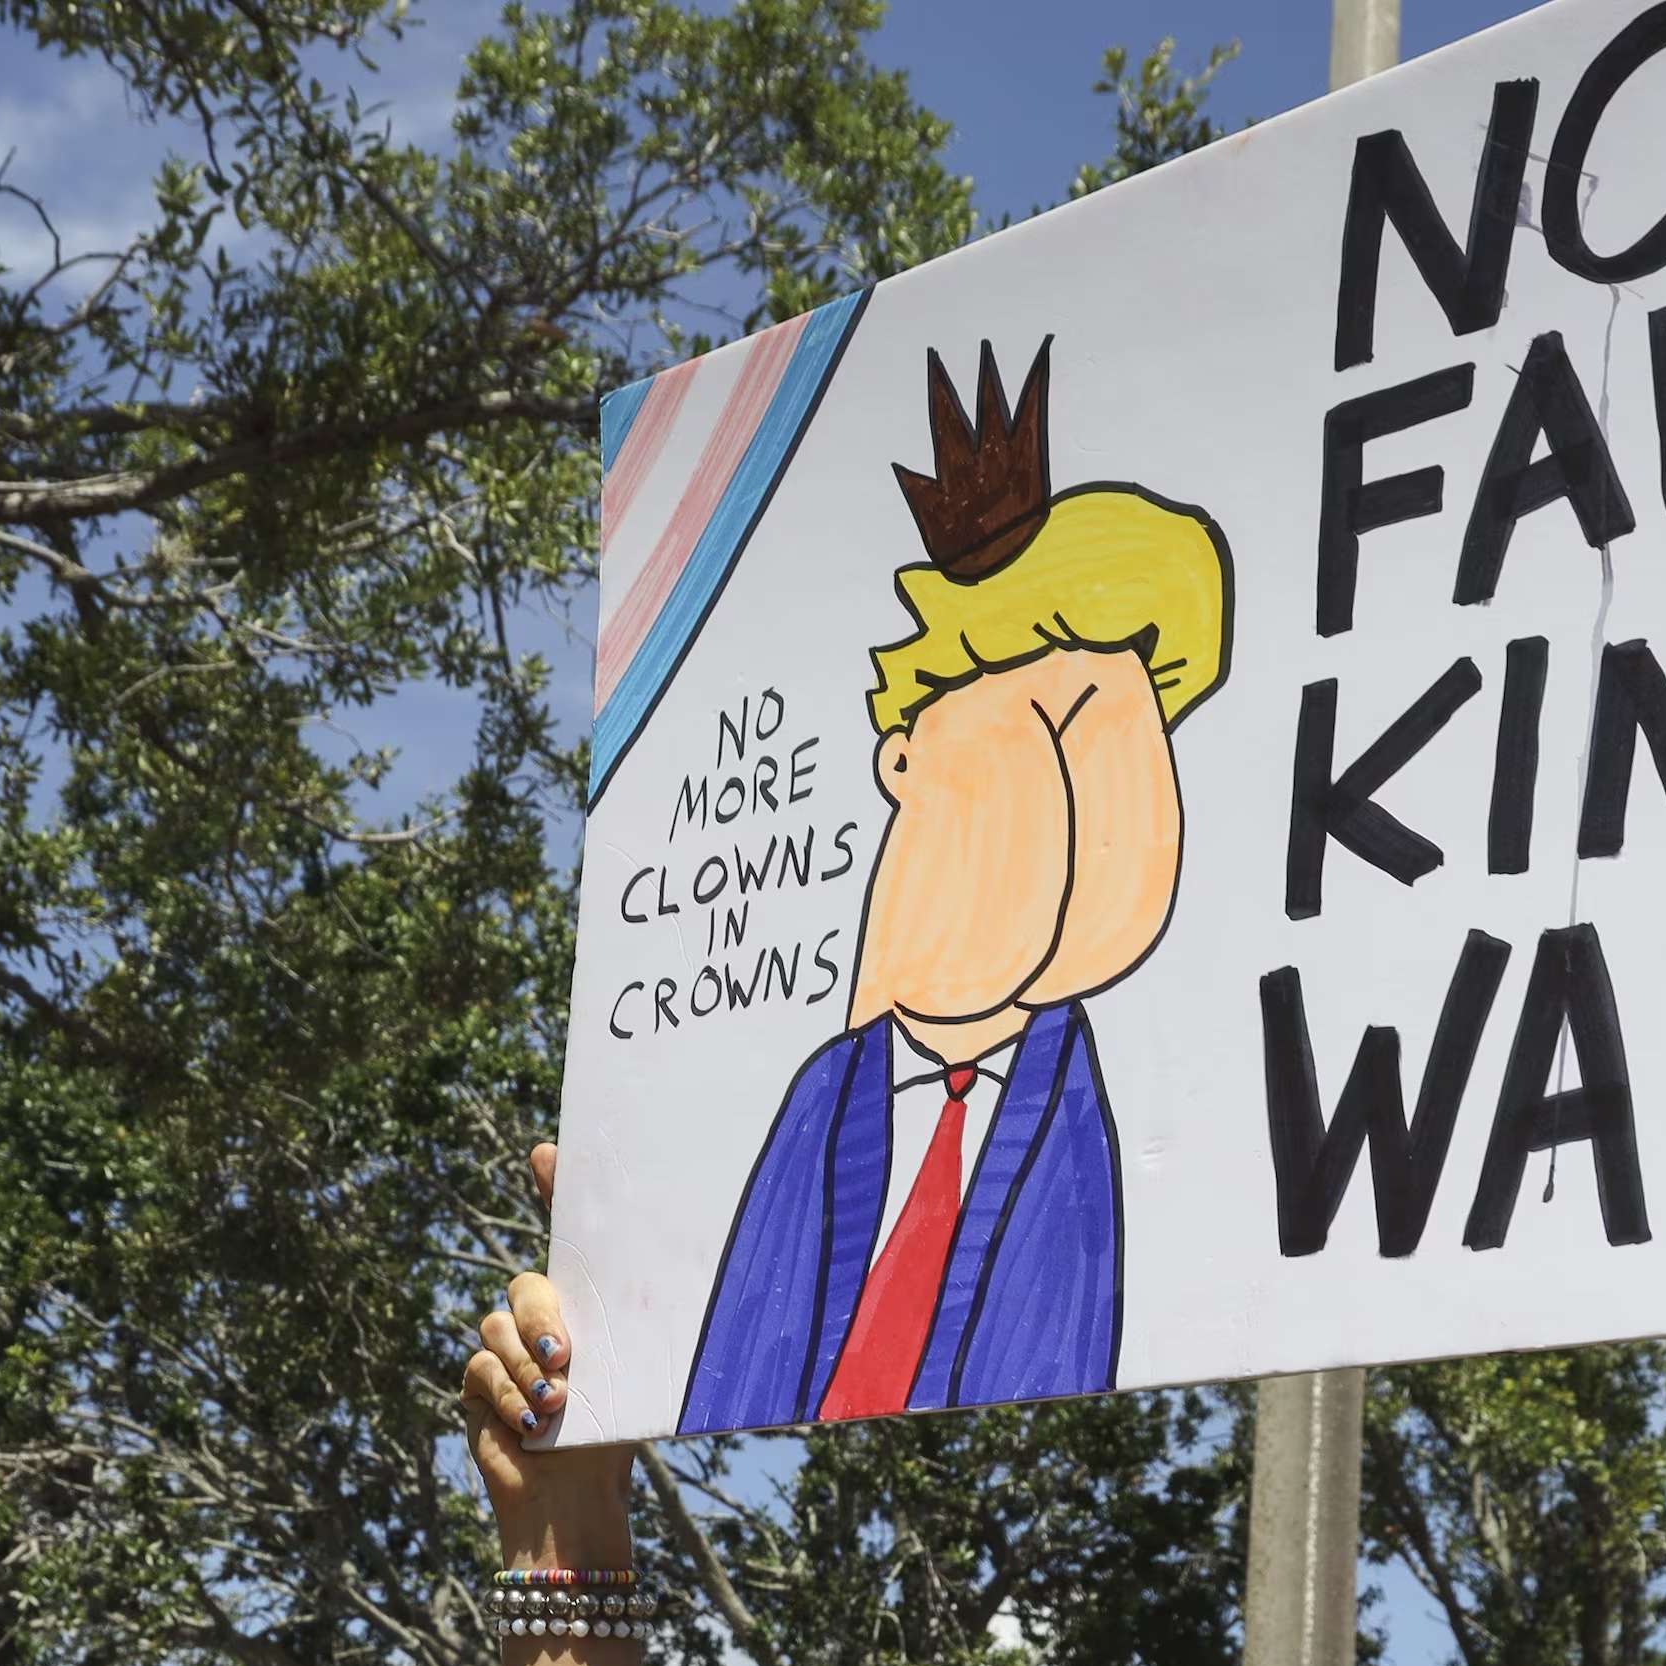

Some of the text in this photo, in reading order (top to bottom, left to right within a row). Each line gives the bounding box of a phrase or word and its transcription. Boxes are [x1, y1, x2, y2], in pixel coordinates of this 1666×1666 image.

[717, 687, 784, 769] NO
[669, 737, 820, 843] MORE
[621, 822, 858, 924] CLOWNS
[707, 900, 749, 957] IN
[609, 929, 840, 1040] CROWNS
